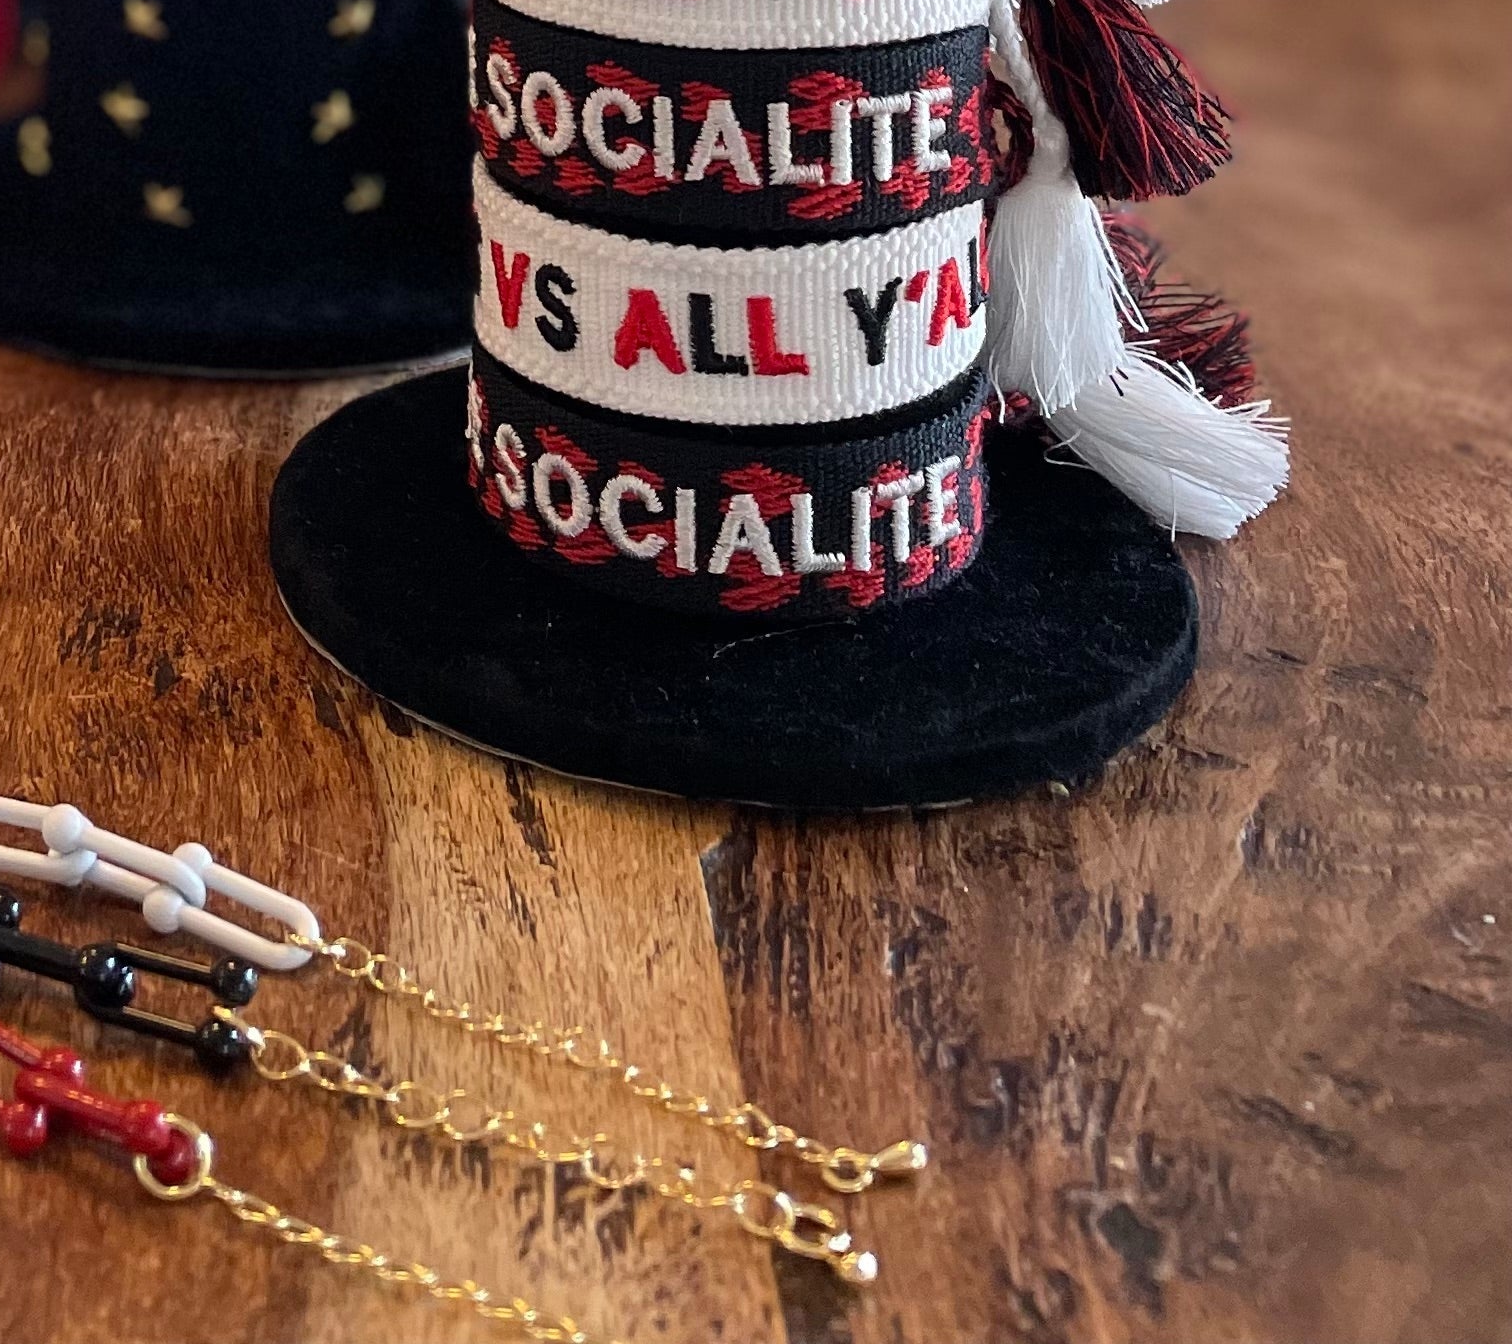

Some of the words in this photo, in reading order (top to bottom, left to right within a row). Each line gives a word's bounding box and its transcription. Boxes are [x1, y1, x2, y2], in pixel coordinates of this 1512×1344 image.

[487, 53, 952, 187] SOCIALITE
[490, 240, 578, 352] VS
[614, 289, 810, 375] ALL
[494, 423, 962, 577] SOCIALITE
